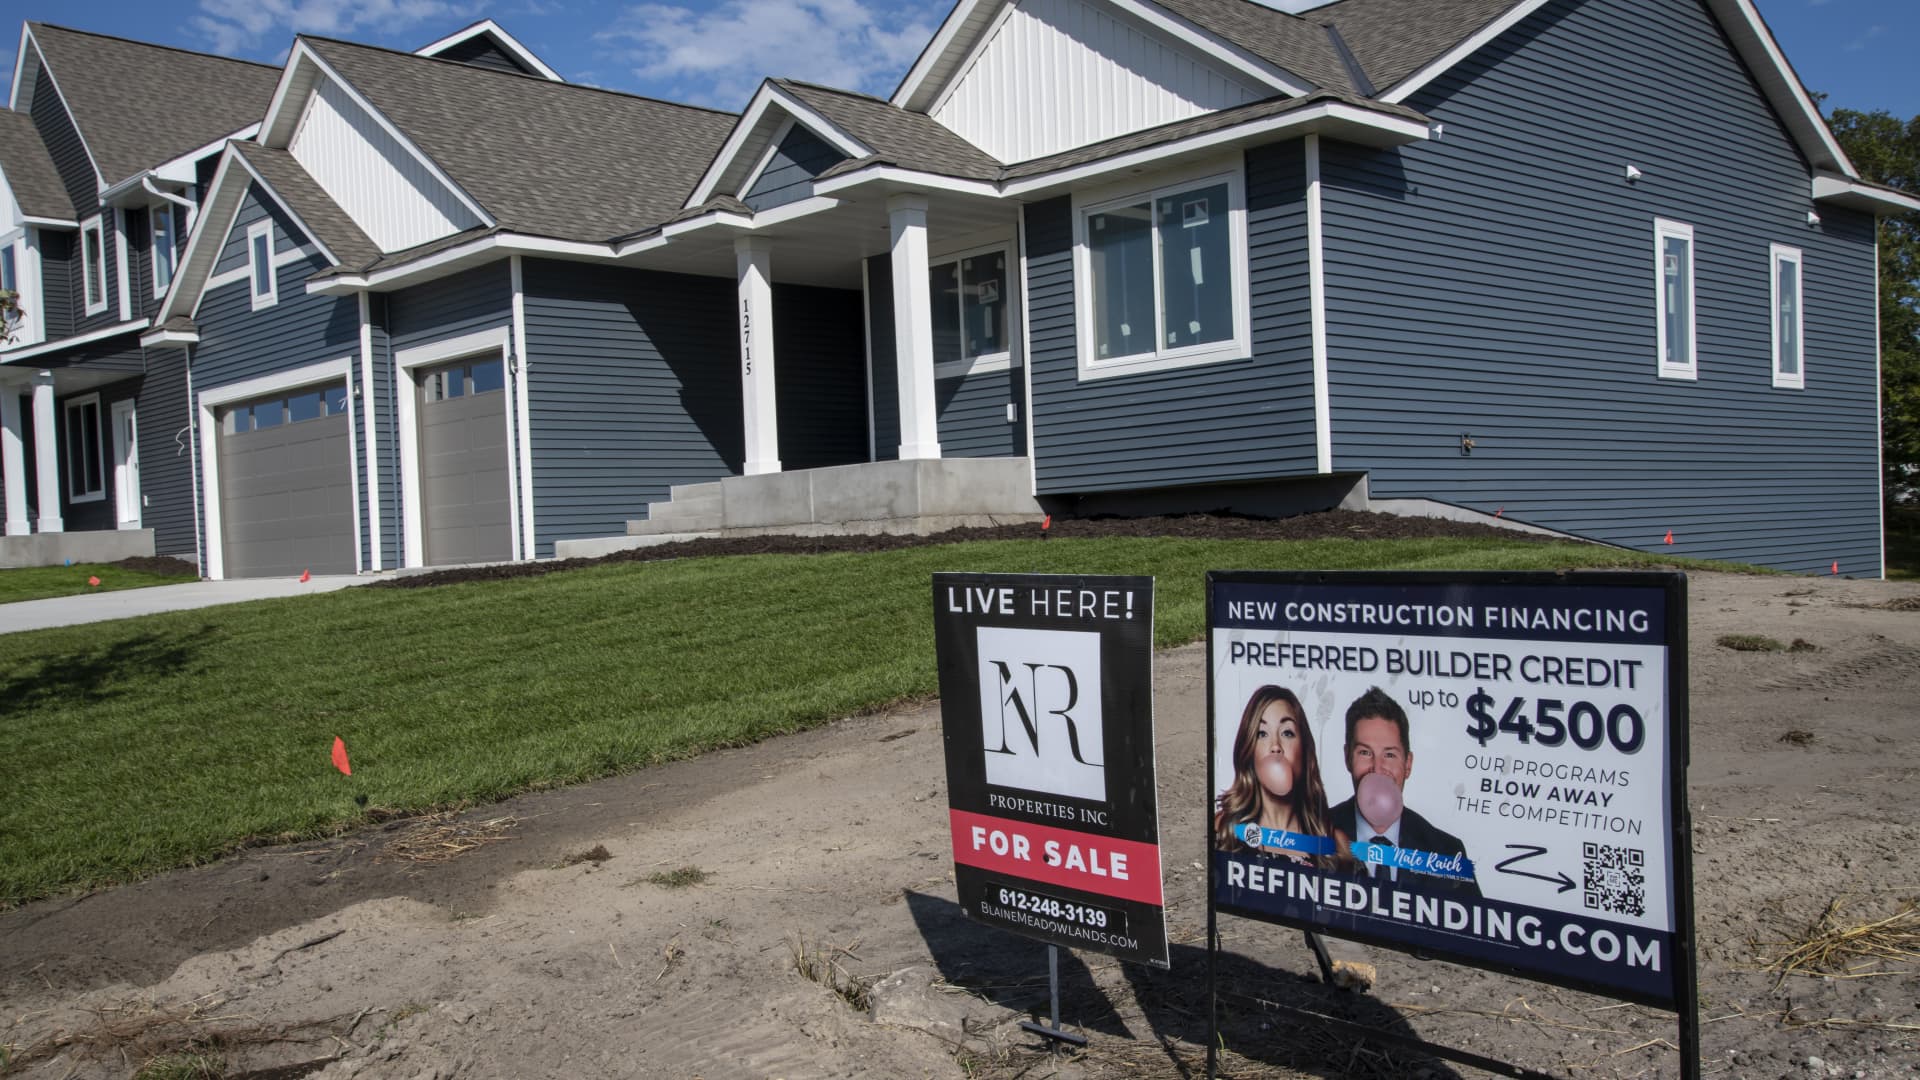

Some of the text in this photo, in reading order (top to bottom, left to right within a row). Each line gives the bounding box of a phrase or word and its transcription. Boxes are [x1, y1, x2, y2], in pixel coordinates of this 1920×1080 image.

[743, 299, 751, 375] 12715
[948, 587, 1134, 619] LIVE HERE!
[1228, 601, 1649, 633] NEW CONSTRUCTION FINANCING
[1231, 641, 1643, 690] PREFERRED BUILDER CREDIT
[1408, 686, 1646, 755] up to $4500
[1464, 754, 1630, 787] OUR PROGRAMS
[990, 794, 1108, 826] PROPERTIES INC
[1480, 778, 1614, 808] BLOW AWAY
[1456, 795, 1643, 836] THE COMPETITION
[971, 826, 1129, 880] FOR SALE
[1392, 845, 1462, 873] Nate Raich
[999, 889, 1107, 927] 612-248-3139
[1227, 860, 1661, 972] REFINEDLENDING.COM
